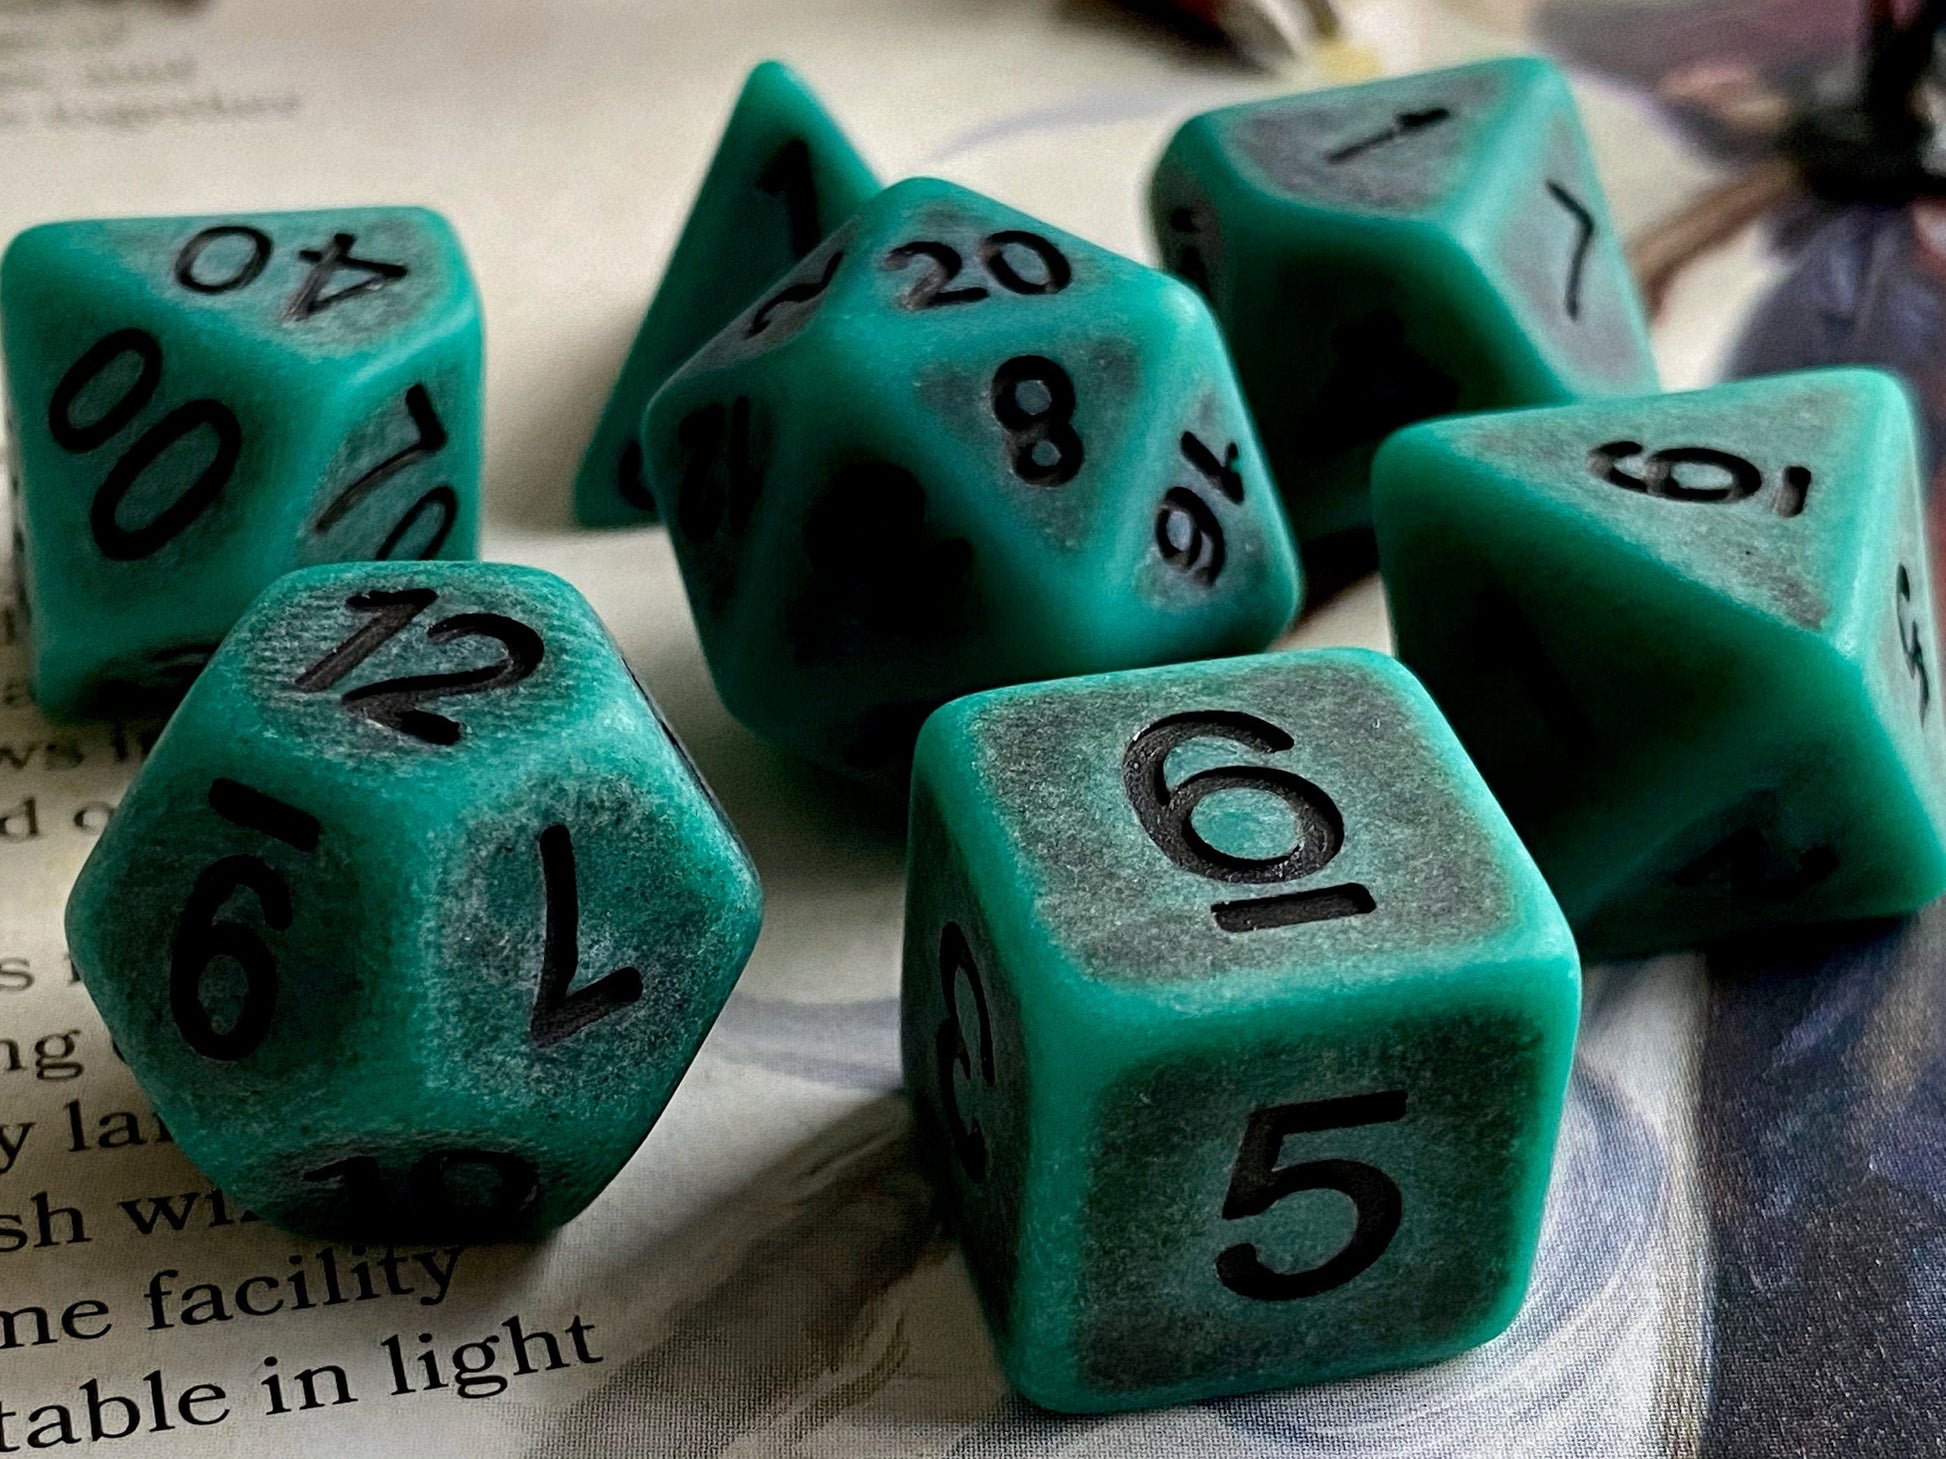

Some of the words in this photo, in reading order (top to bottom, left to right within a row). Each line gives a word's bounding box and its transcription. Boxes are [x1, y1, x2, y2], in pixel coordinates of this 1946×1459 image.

[755, 138, 822, 262] 1
[881, 230, 1071, 312] 20
[1545, 179, 1595, 322] 7
[48, 327, 242, 562] 00
[990, 355, 1085, 488] 8
[1154, 430, 1246, 588] 16
[294, 587, 545, 746] 12
[1122, 709, 1378, 934] 6
[529, 823, 645, 1050] 7
[117, 1188, 260, 1235] wi
[1215, 1087, 1410, 1302] 5
[143, 1245, 466, 1330] facility
[260, 1355, 360, 1416] in
[379, 1314, 605, 1400] light
